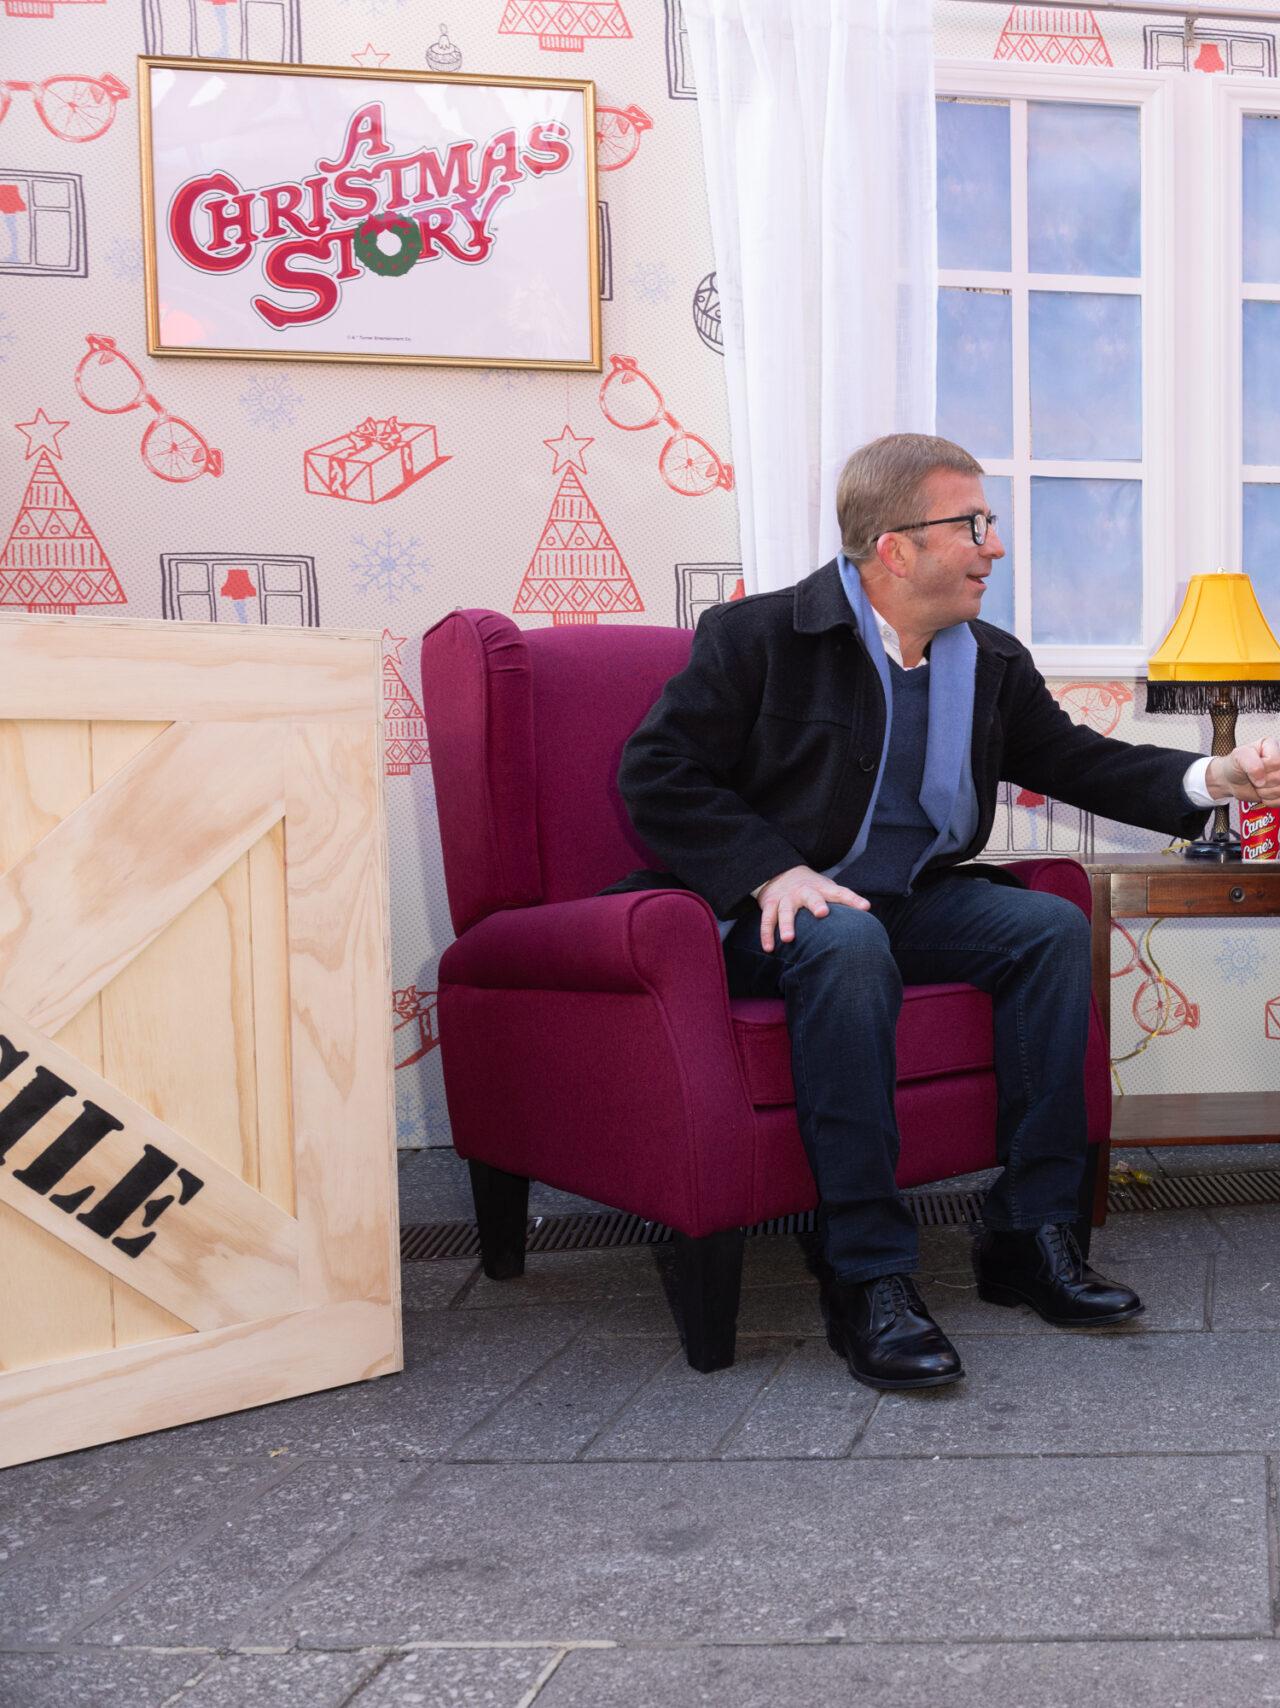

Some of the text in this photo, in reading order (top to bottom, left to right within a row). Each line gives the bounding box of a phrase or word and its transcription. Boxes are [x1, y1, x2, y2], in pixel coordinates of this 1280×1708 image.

[170, 124, 571, 272] CHRISTMAS
[319, 101, 391, 173] A
[254, 186, 511, 328] STORY
[1242, 812, 1275, 840] Cane's
[0, 1034, 205, 1259] ILE
